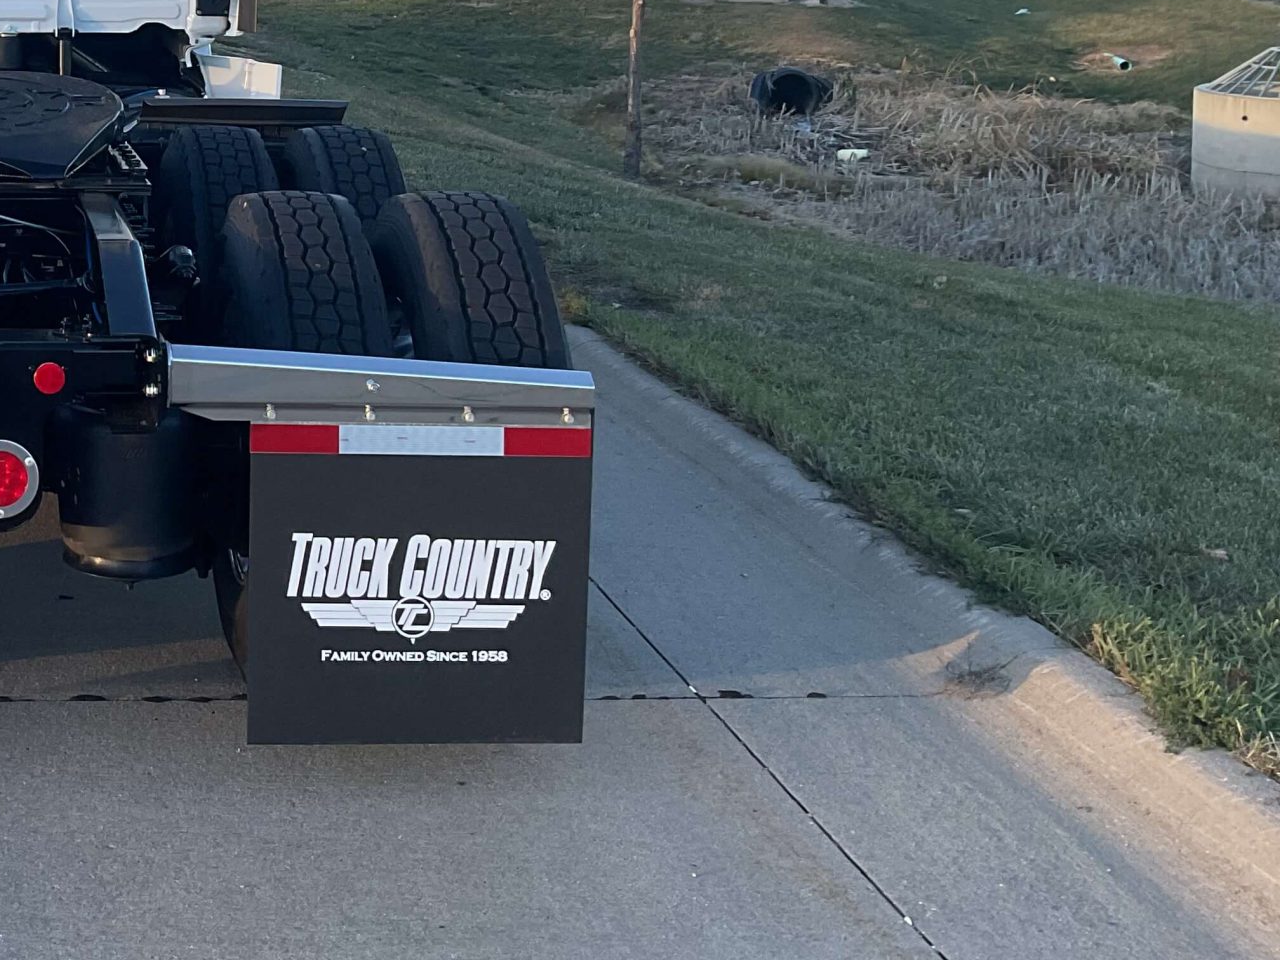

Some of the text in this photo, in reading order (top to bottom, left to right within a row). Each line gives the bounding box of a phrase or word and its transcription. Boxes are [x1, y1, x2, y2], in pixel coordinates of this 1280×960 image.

[287, 533, 556, 600] TRUCK COUNTRY
[321, 649, 508, 662] FAMILY OWNED SINCE 1958
